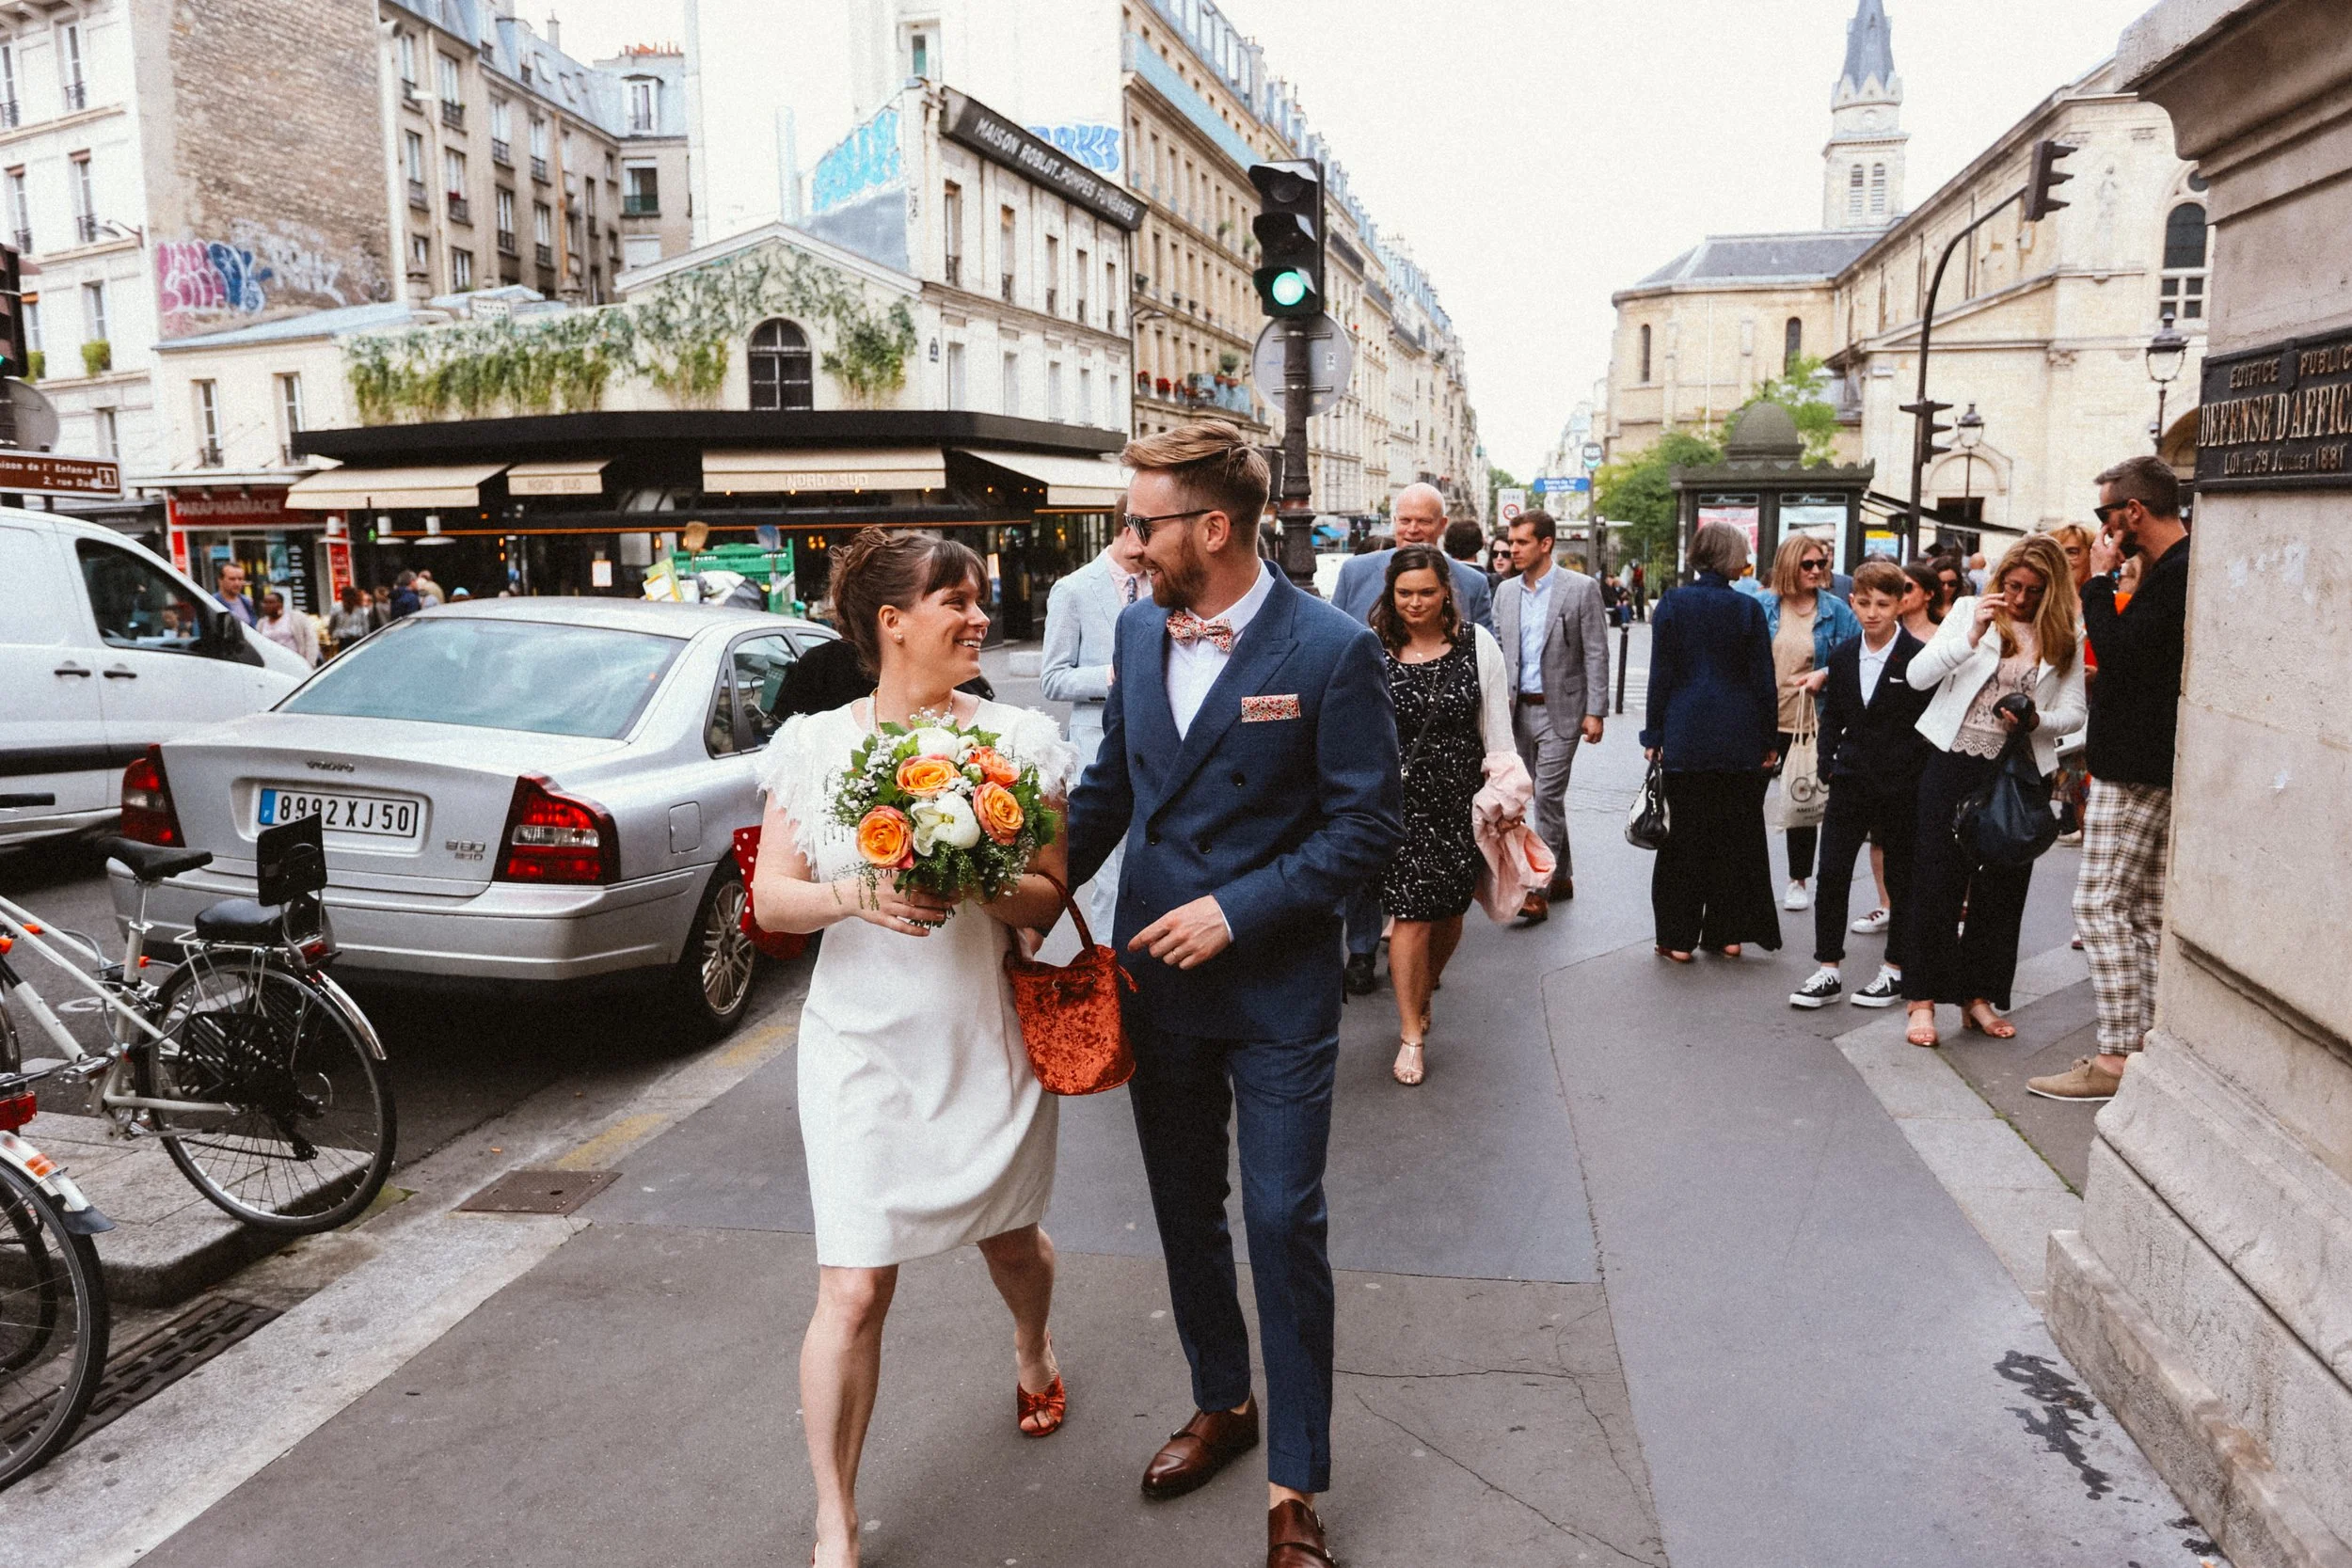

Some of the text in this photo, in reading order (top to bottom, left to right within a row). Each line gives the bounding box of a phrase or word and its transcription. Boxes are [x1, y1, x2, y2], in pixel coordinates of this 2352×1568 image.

[975, 118, 1021, 155] MAISON
[1059, 166, 1096, 198] POMPES
[2230, 357, 2281, 388] EDIFICE
[2200, 383, 2352, 447] DEFENSE D'AFFIC
[26, 462, 40, 471] de
[55, 464, 93, 475] Enfance
[2224, 451, 2241, 475] LOI
[2255, 450, 2269, 472] 29
[2315, 443, 2347, 470] 1881
[786, 472, 868, 488] NORD SUD
[176, 498, 281, 515] PARAPHARMACIE
[345, 800, 373, 828] XJ
[381, 804, 409, 832] 50
